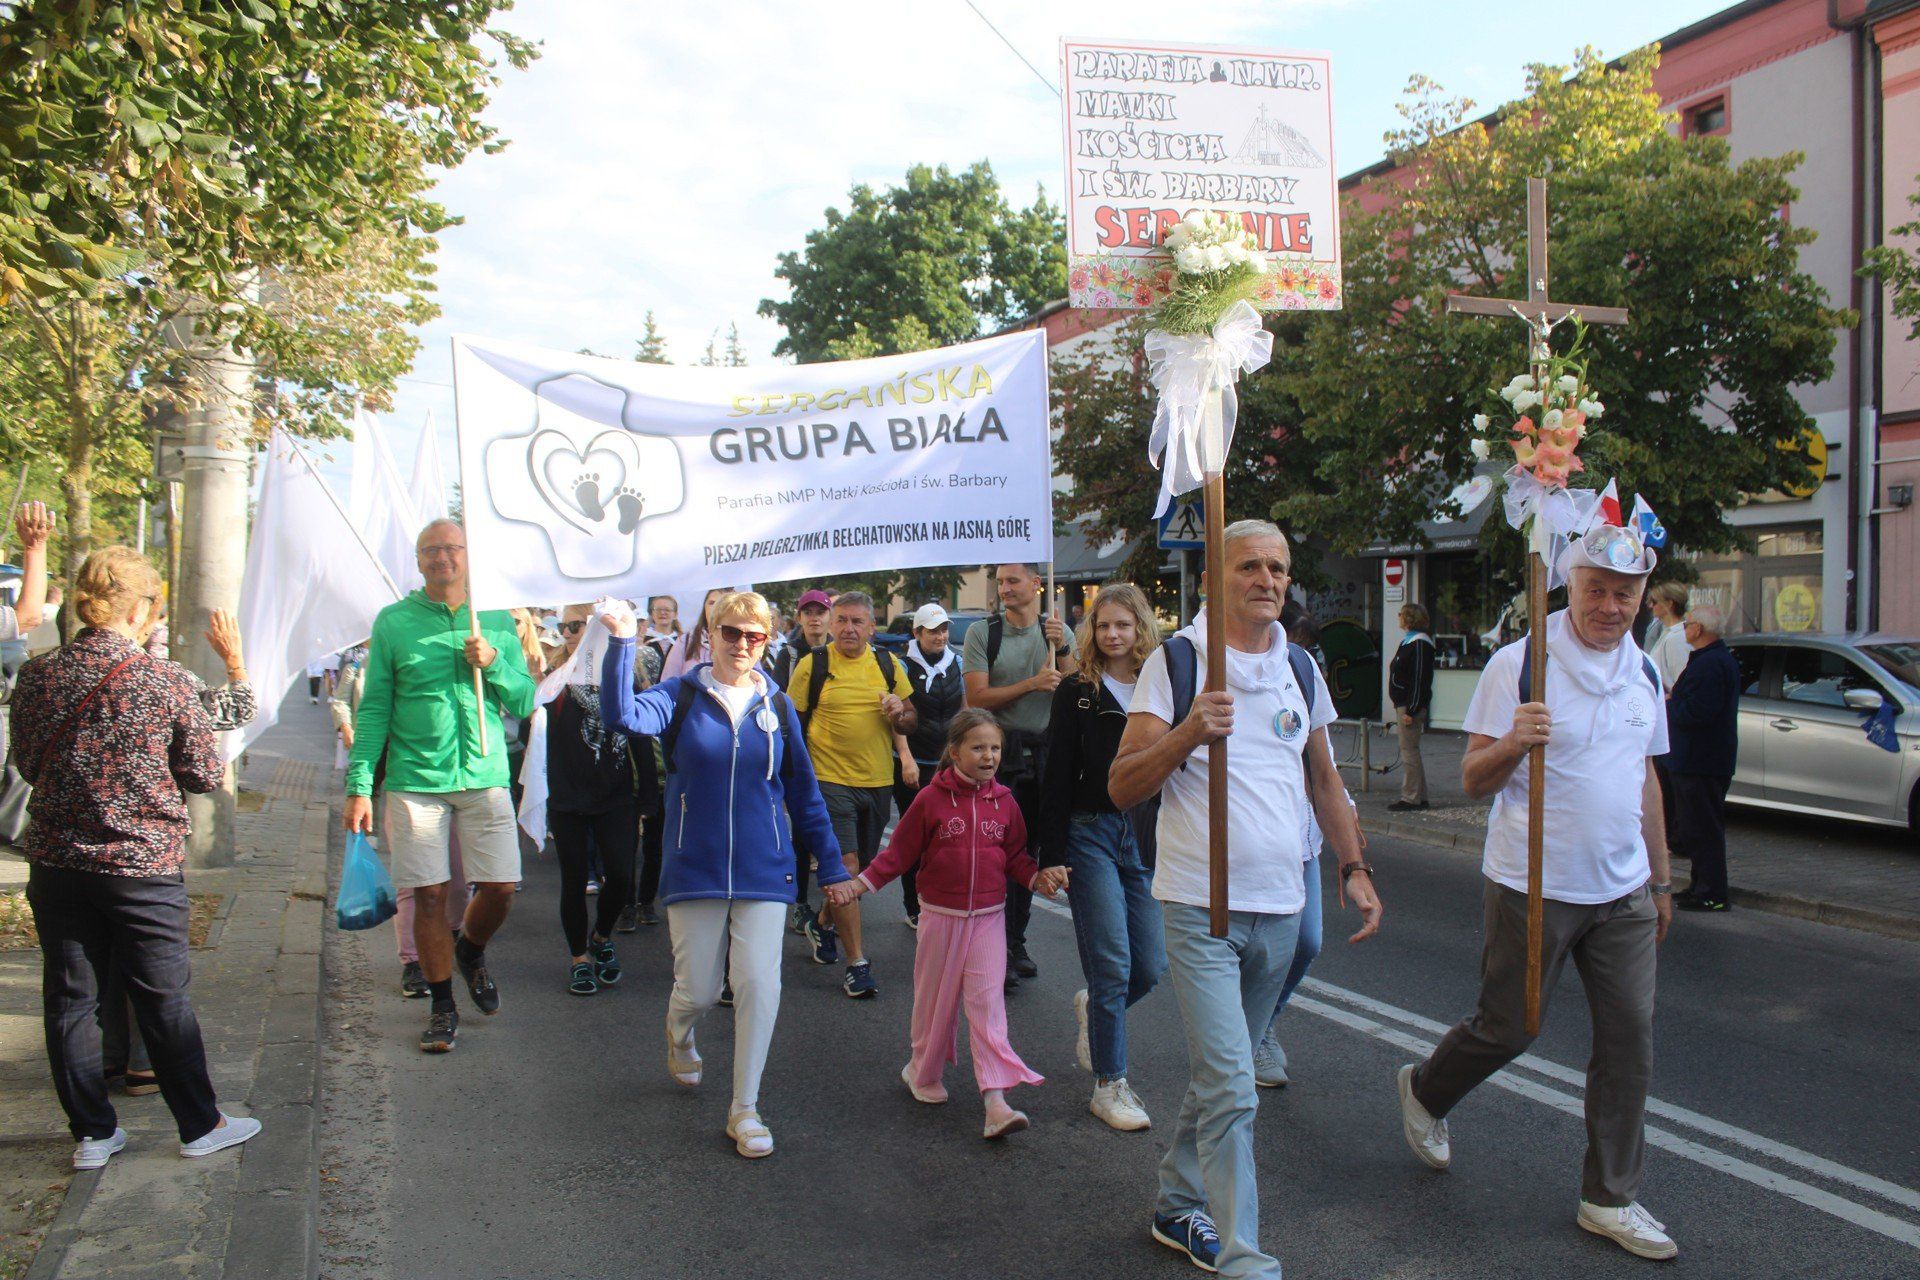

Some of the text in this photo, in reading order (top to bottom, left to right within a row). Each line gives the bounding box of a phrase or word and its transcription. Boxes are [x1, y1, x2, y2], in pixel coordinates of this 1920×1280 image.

[1073, 51, 1321, 90] PARAFIA N.M.P.
[1076, 90, 1177, 121] MATKI
[1077, 121, 1228, 162] KOŚCIOŁA
[1077, 160, 1299, 204] I ŚW. BARBARY
[1094, 205, 1312, 254] SERNIE
[709, 407, 1009, 465] GRUPA BIAŁA
[717, 473, 1008, 510] Parafia NMP Matki Kościoła i św. Barbary
[704, 515, 1031, 566] PIESZA PIELGRZYMKA BEŁCHATOWSKA NA JASNĄ GÓRĘ
